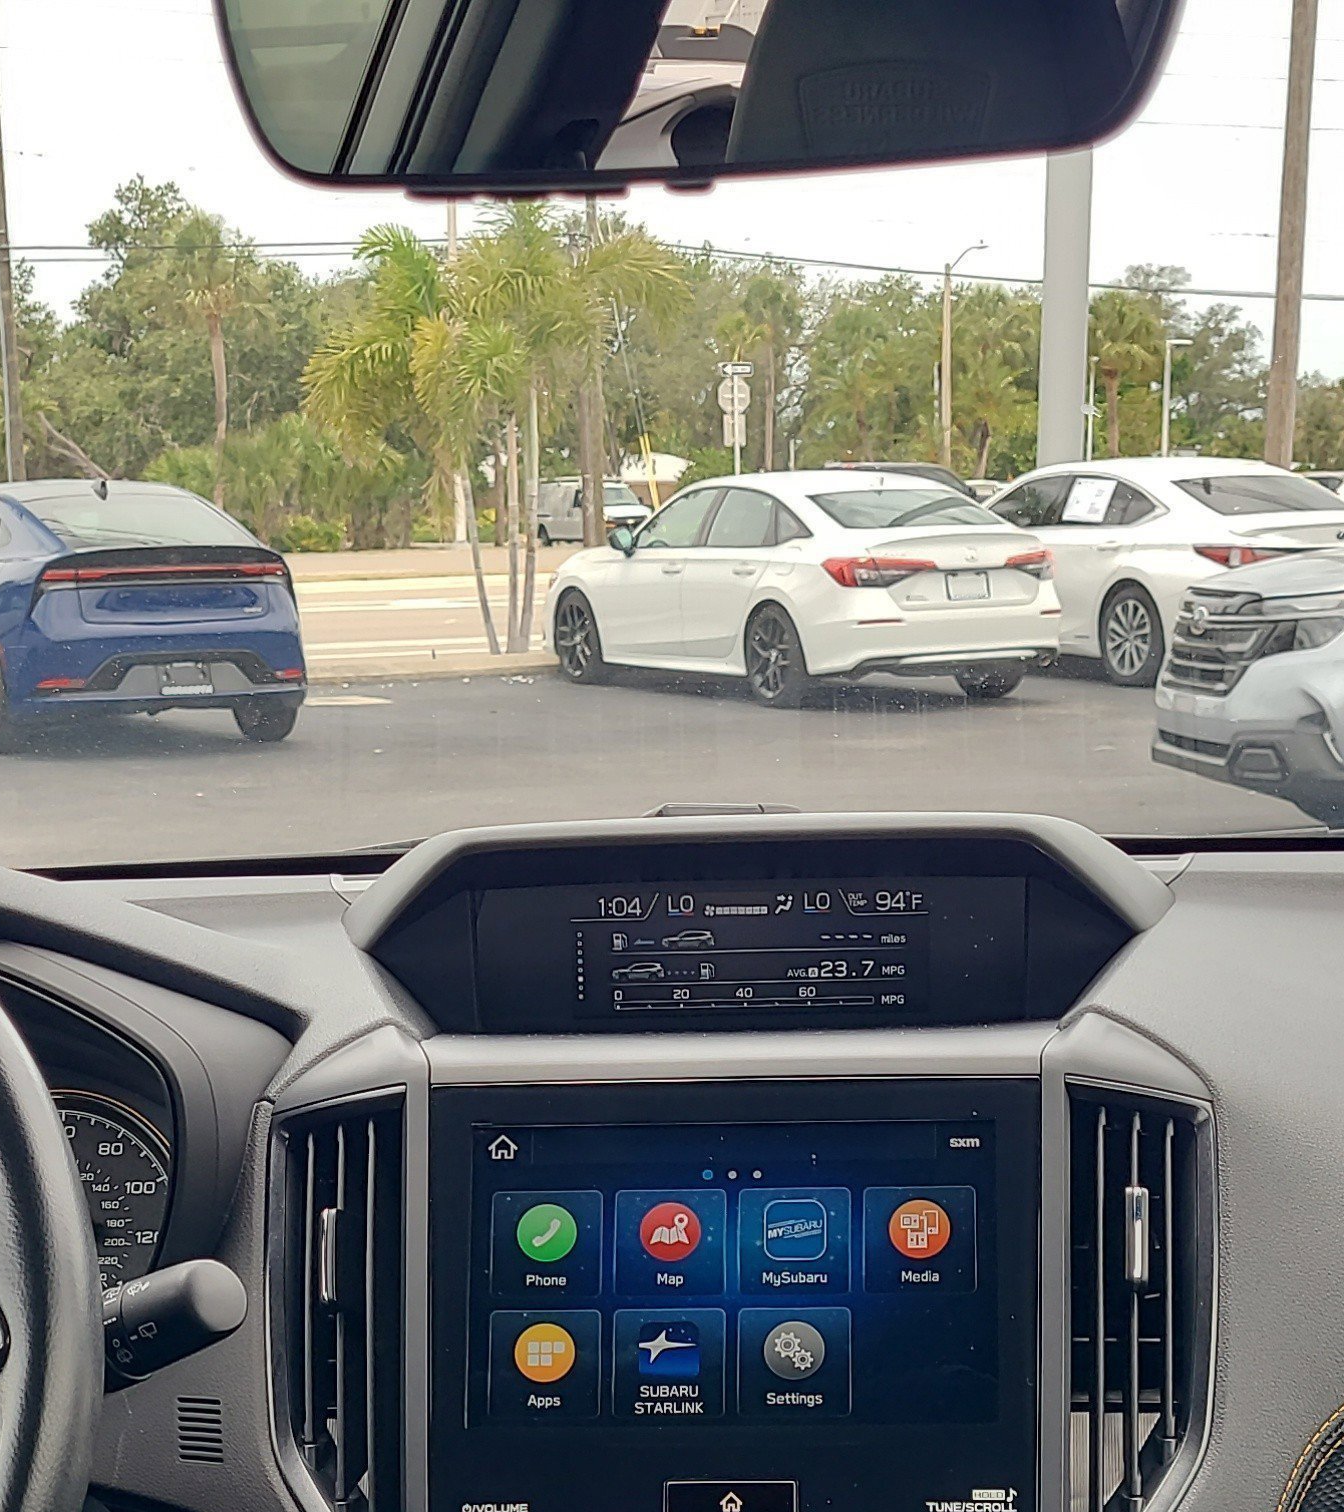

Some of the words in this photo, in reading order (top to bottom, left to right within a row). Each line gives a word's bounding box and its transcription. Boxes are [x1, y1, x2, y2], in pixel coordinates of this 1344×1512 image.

[598, 897, 643, 917] 1:04
[667, 895, 694, 913] LO
[804, 892, 830, 910] LO
[875, 891, 923, 911] 94°F
[880, 934, 906, 944] miles
[820, 961, 875, 977] 23.7
[881, 966, 905, 975] MPG
[673, 989, 690, 999] 20
[735, 987, 753, 998] 40
[798, 986, 816, 997] 60
[881, 995, 905, 1004] MPG
[949, 1136, 981, 1148] sxm
[98, 1143, 123, 1156] 80
[91, 1184, 110, 1192] 140
[124, 1181, 156, 1194] 100
[100, 1201, 120, 1209] 160
[106, 1219, 125, 1228] 180
[104, 1238, 124, 1246] 200
[525, 1274, 567, 1286] Phone
[656, 1272, 684, 1287] Map
[761, 1271, 828, 1287] MySubaru
[900, 1270, 940, 1283] Media
[639, 1385, 699, 1398] SUBARU
[527, 1394, 561, 1409] Apps
[766, 1392, 823, 1408] Settings
[634, 1402, 704, 1414] STARLINK
[925, 1502, 1018, 1512] TUNE/SCROLL
